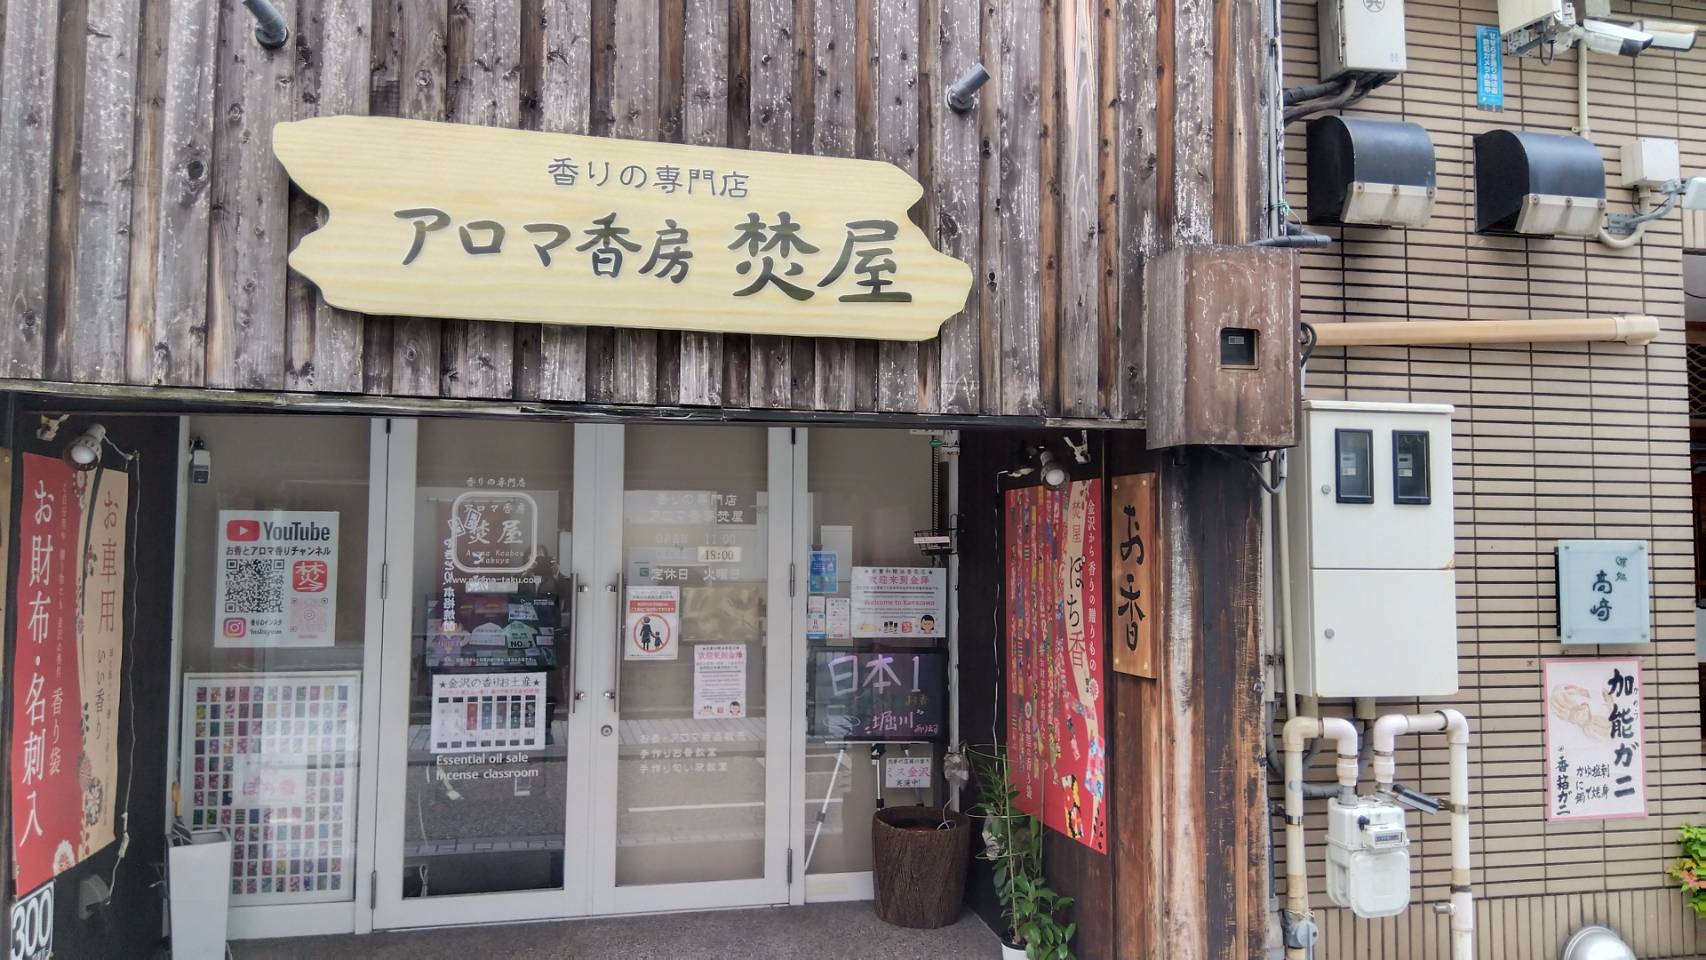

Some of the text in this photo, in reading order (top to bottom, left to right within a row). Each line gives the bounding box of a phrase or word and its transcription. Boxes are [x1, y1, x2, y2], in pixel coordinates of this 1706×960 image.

[547, 157, 750, 198] 香りの専門店
[393, 207, 913, 303] アロマ香房 焚屋
[225, 545, 332, 556] お香とアロマ香りチャンネル
[263, 521, 331, 541] YouTube
[704, 549, 735, 561] 18:00
[99, 490, 119, 634] お車用
[650, 567, 689, 581] 定休日
[1087, 500, 1098, 672] 金沢から香りの贈りもの
[1118, 504, 1146, 652] お香
[1066, 555, 1086, 670] ぽち香
[19, 480, 54, 848] お財布・名刺入
[448, 676, 532, 689] 金沢の香りお土産
[48, 687, 64, 774] 香り袋
[436, 752, 529, 766] Essential oil sale
[1608, 668, 1639, 798] 加能ガニ
[483, 768, 539, 779] classroom
[1555, 756, 1573, 816] 香箱ガニ
[1602, 763, 1610, 800] 刺身
[9, 888, 51, 960] 300
